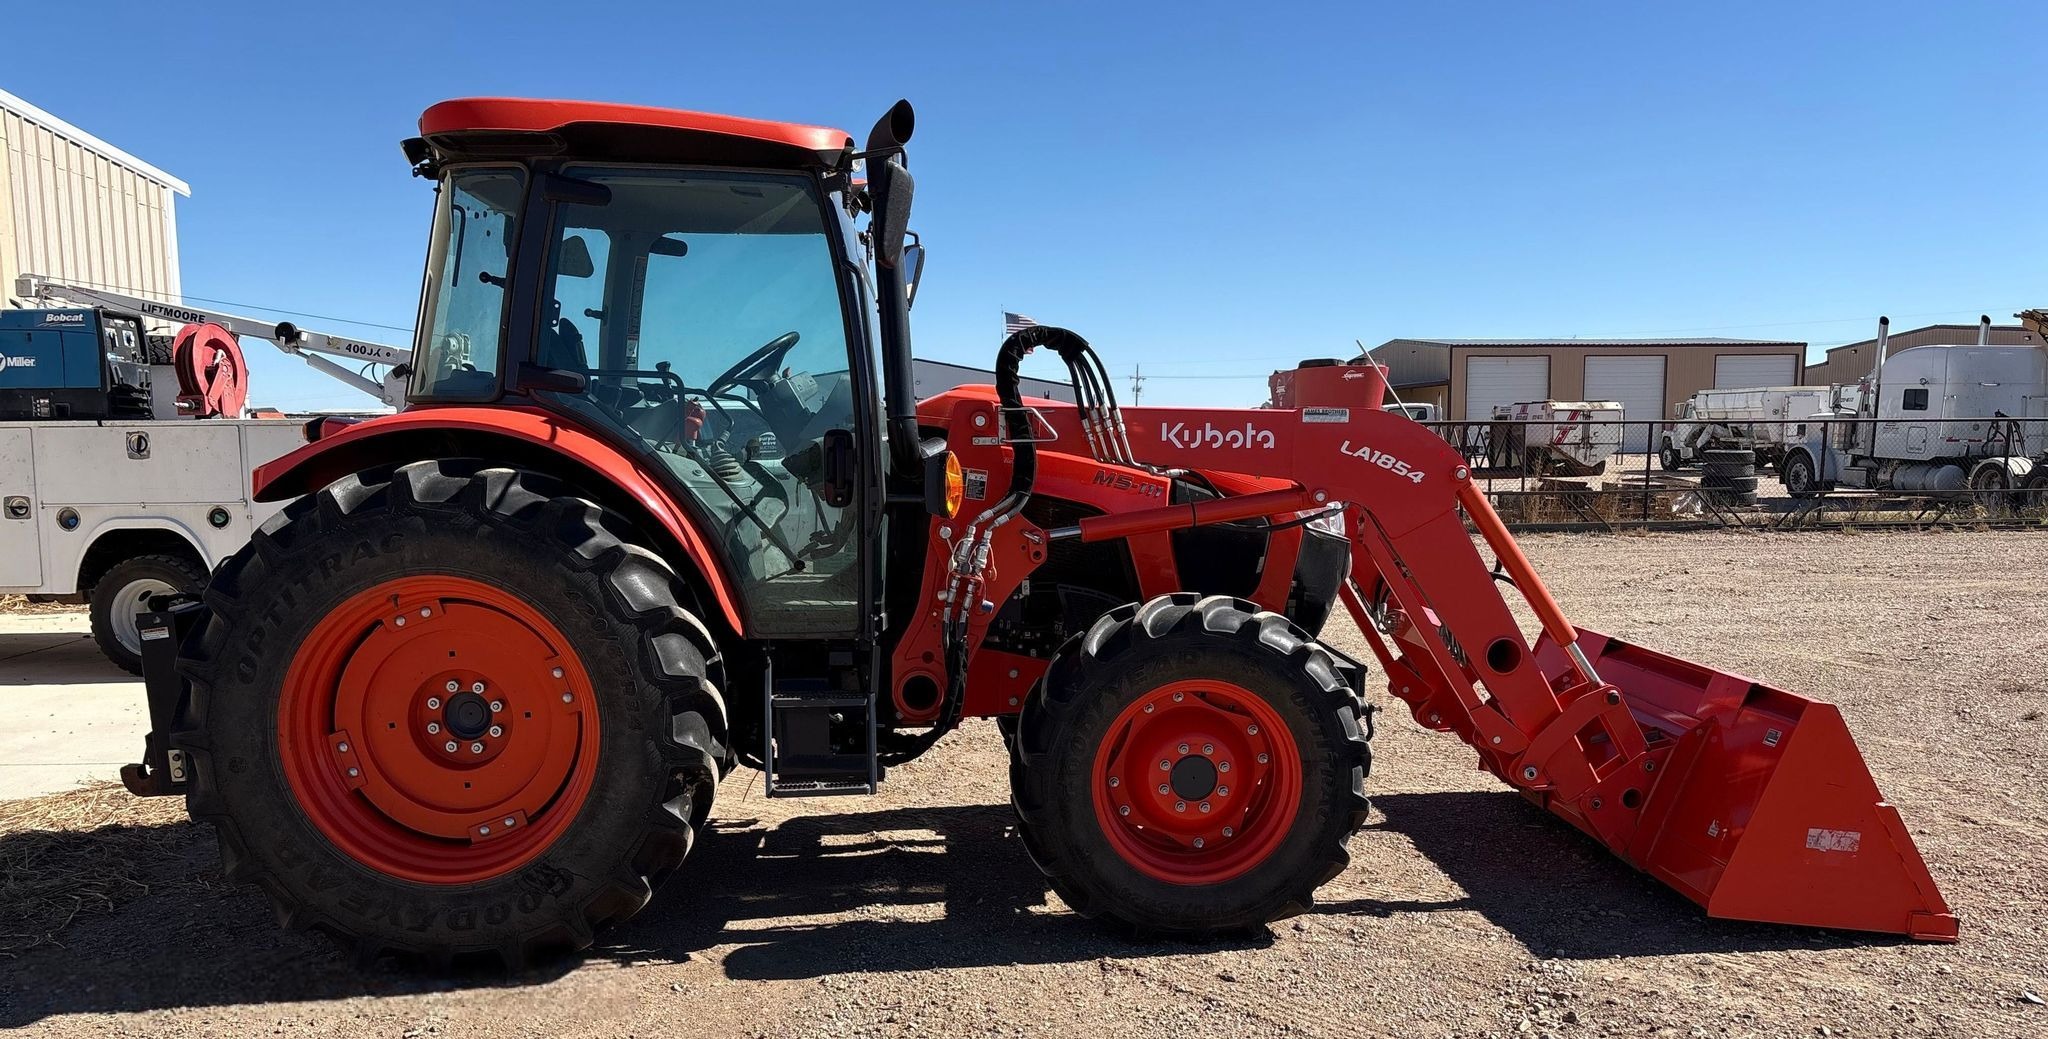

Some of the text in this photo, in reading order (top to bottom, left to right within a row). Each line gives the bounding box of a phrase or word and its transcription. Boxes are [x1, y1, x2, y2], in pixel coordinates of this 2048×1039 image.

[45, 313, 84, 322] Bobcat
[141, 303, 206, 324] LIFTMOORE
[1161, 422, 1275, 449] Kubota
[1340, 440, 1425, 484] LA1854
[1092, 469, 1164, 498] M5-111
[237, 531, 406, 685] OPTITRAC
